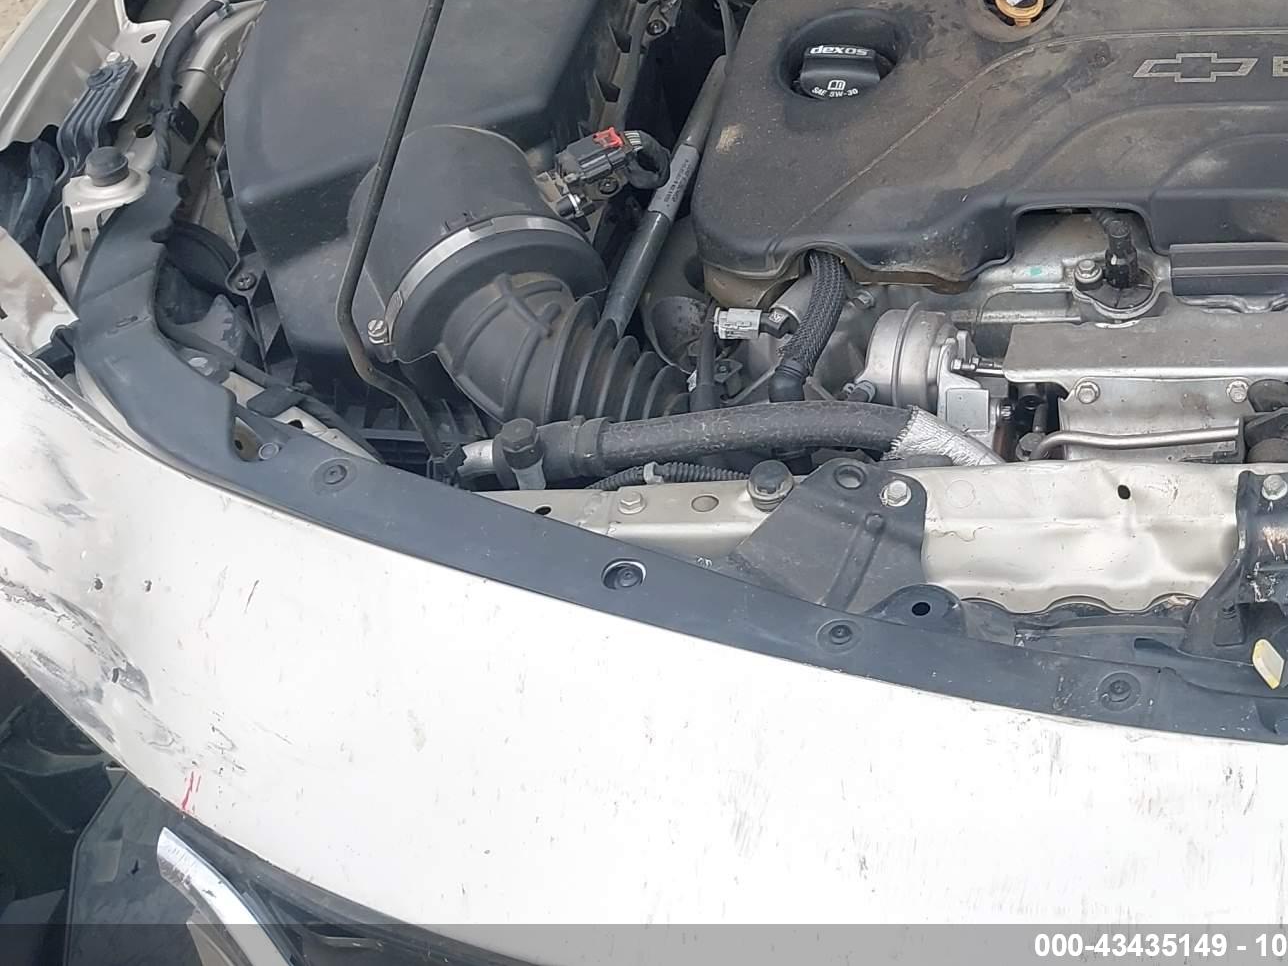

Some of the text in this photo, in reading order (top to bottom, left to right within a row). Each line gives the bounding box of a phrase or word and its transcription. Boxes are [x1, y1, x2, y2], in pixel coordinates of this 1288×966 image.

[810, 44, 870, 57] dexos
[811, 86, 859, 98] SAE 5W-30
